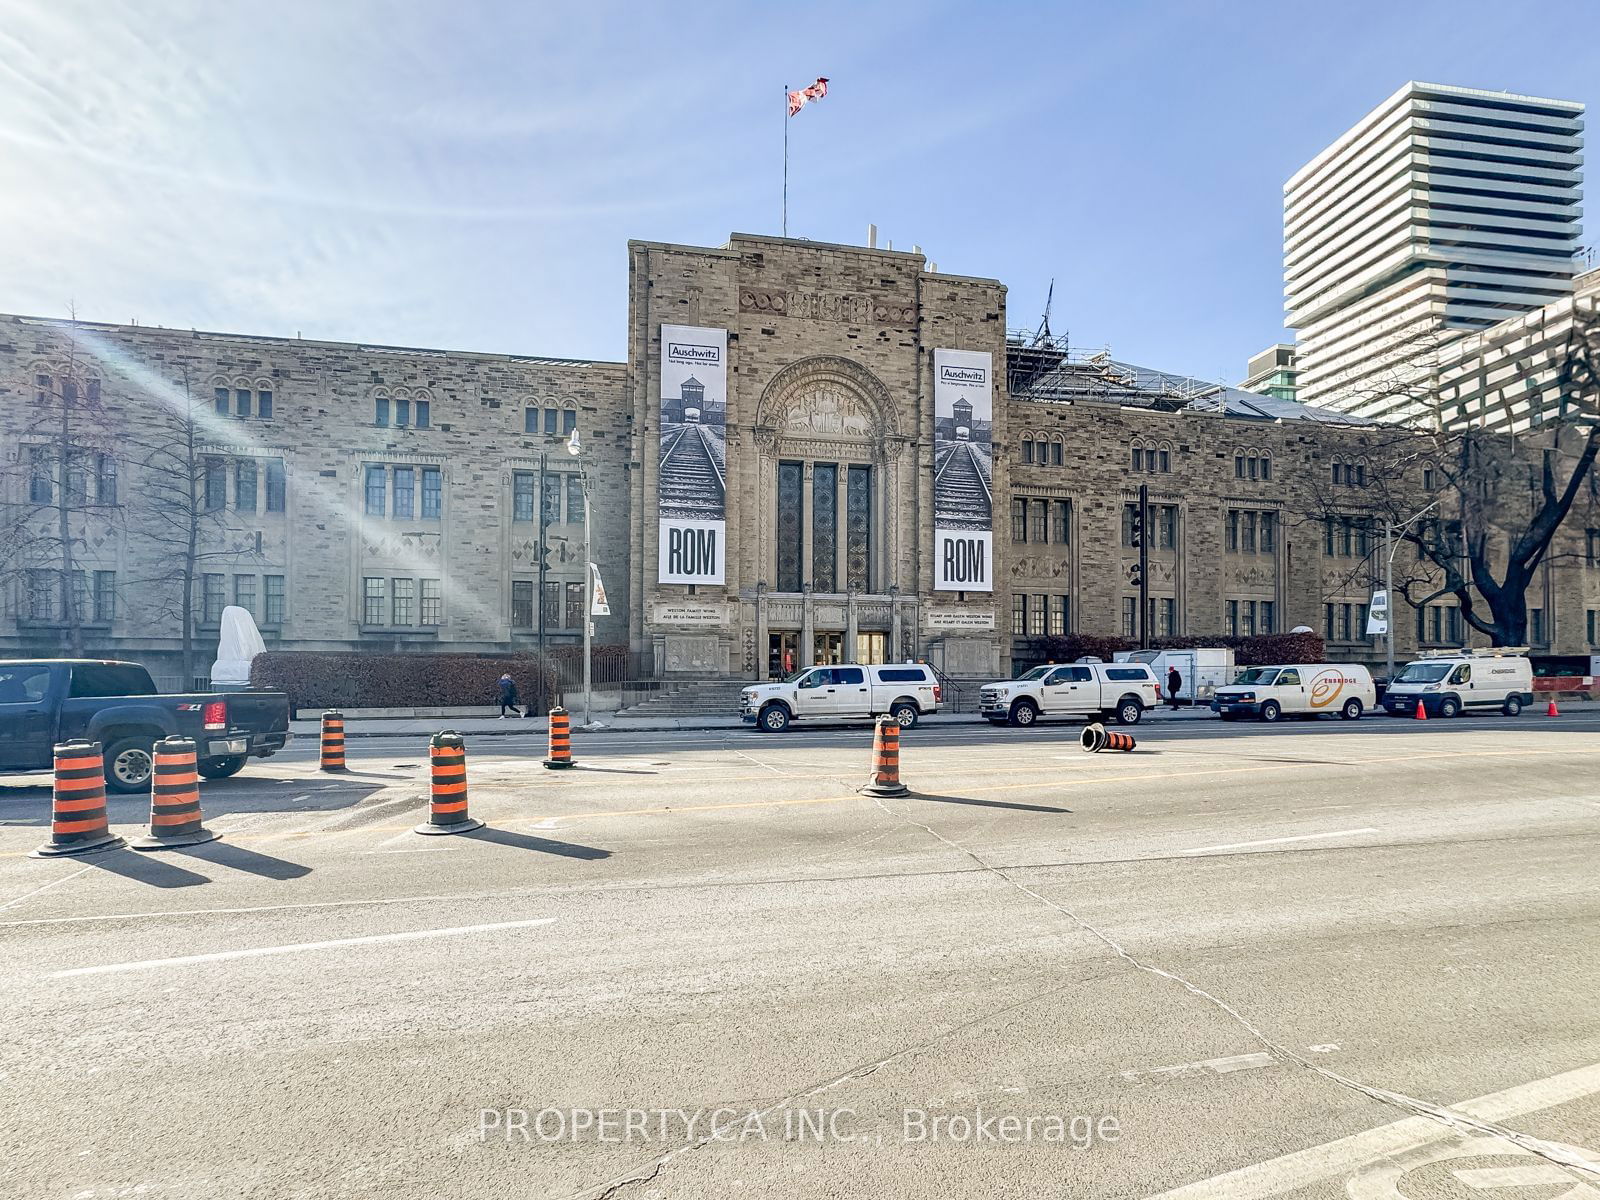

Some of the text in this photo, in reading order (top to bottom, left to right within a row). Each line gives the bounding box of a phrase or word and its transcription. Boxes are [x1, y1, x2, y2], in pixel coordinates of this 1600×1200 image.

[672, 346, 716, 358] Auschwitz
[944, 369, 982, 380] Auschwitz
[669, 528, 716, 576] ROM
[944, 538, 984, 583] ROM
